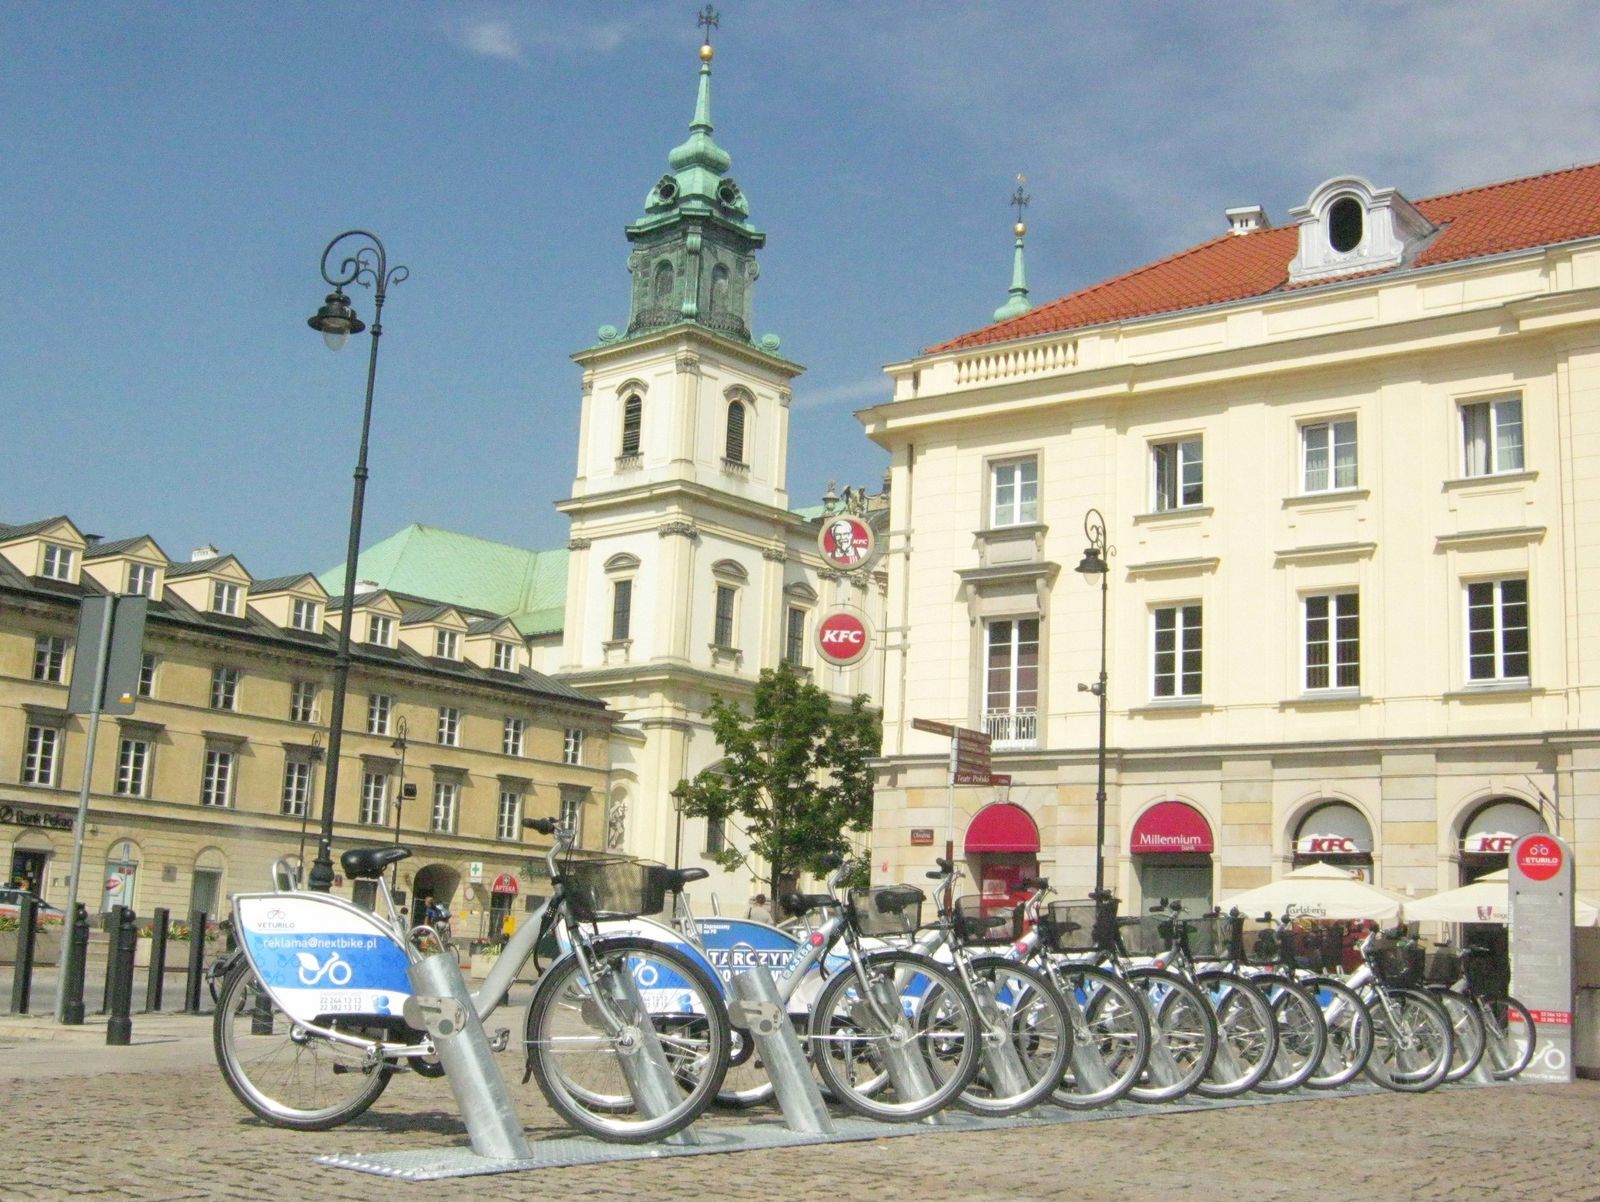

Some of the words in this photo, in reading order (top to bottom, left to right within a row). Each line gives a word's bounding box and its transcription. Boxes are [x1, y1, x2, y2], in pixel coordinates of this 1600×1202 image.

[822, 630, 861, 643] KFC
[16, 810, 42, 824] Bank
[43, 813, 74, 828] Pekao
[1140, 833, 1201, 845] Millennium
[1309, 837, 1354, 853] KFC
[495, 885, 516, 893] APTEKA
[1286, 903, 1327, 918] Carlsberg
[263, 937, 377, 951] reklama@nextbike.pl
